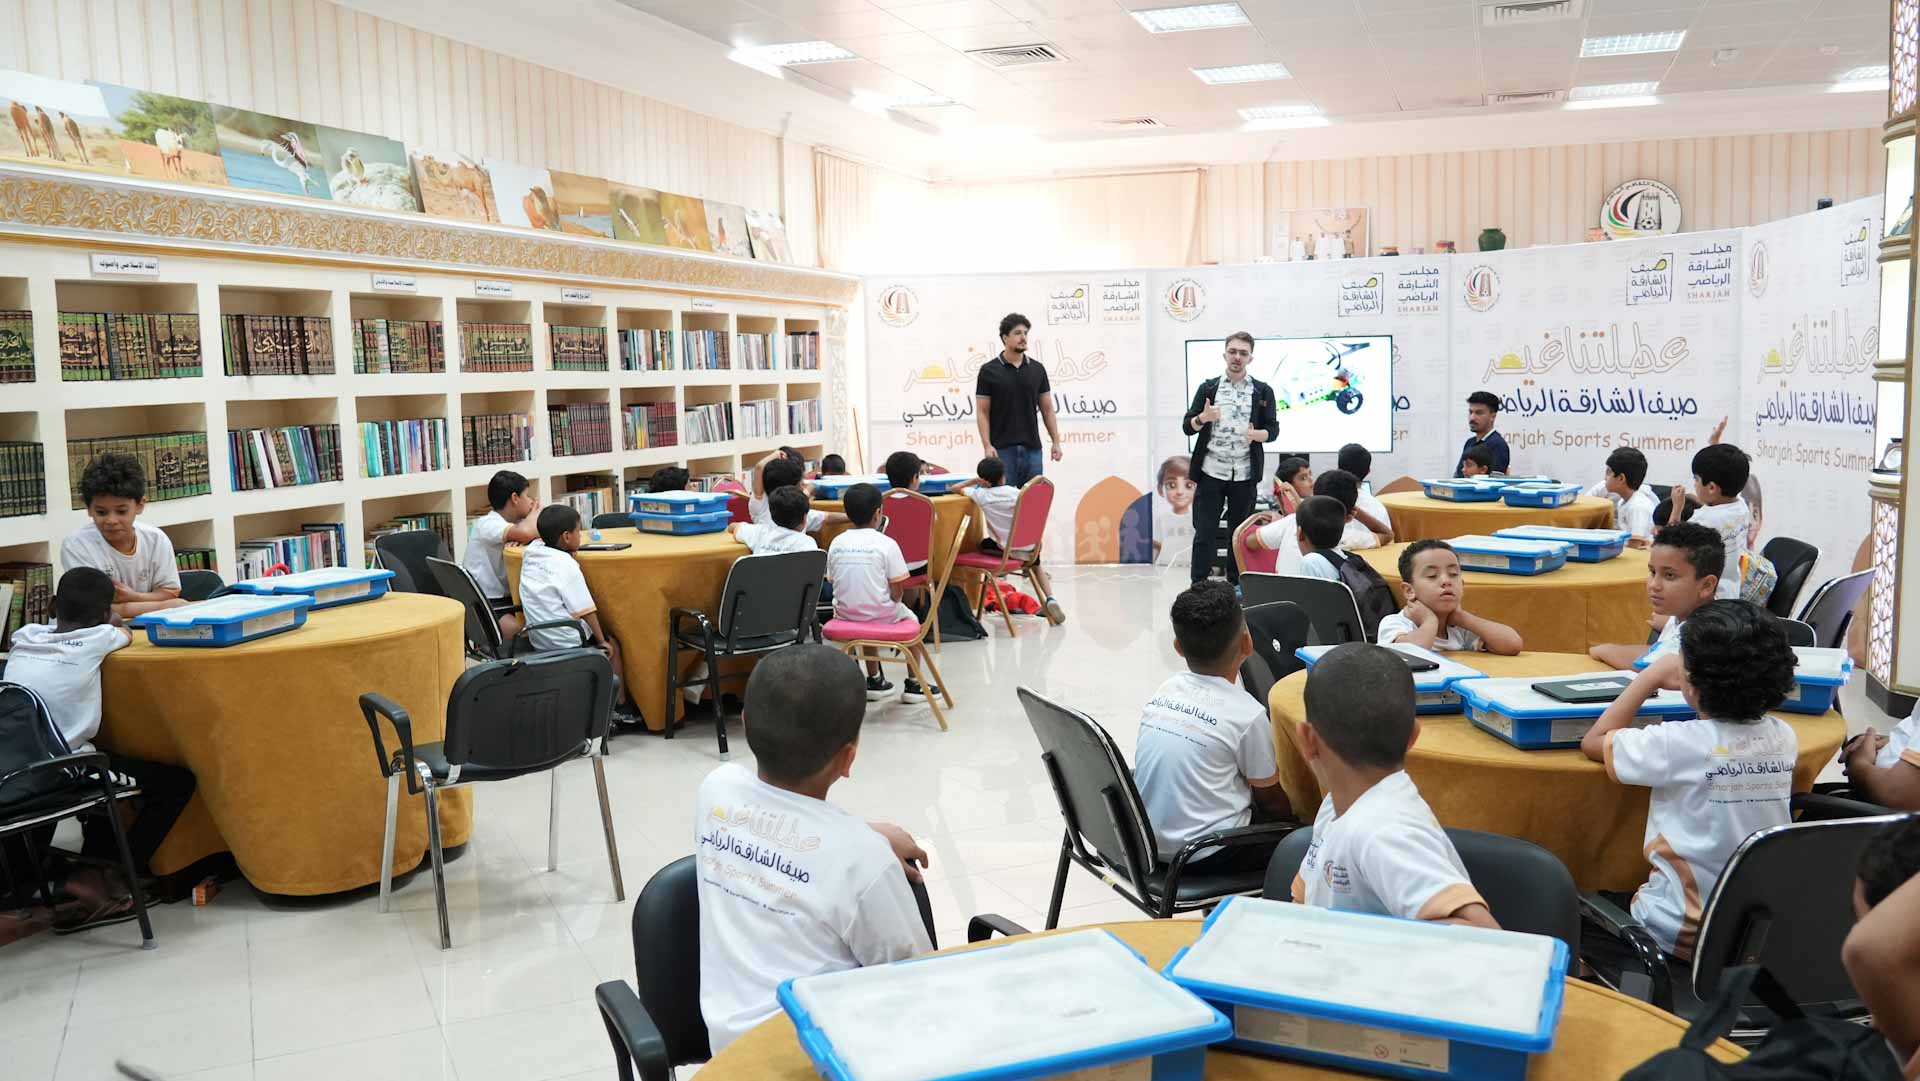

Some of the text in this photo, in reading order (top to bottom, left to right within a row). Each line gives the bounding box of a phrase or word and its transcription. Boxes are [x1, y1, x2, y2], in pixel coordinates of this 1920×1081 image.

[1689, 243, 1732, 255] مجلس
[1399, 266, 1439, 277] مجلس
[1631, 259, 1667, 273] صيف
[1688, 258, 1731, 272] الشارقة
[1103, 278, 1140, 288] مجلس
[1398, 279, 1439, 290] الشارقة
[1632, 274, 1667, 286] الشارقة
[1688, 273, 1730, 288] الرياضي
[1103, 291, 1140, 301] الشارقة
[1343, 290, 1378, 301] الشارقة
[1398, 291, 1438, 303] الرياضي
[1633, 286, 1668, 303] الرياضي
[1688, 290, 1730, 299] SHARJAH
[1103, 303, 1140, 313] الرياضي
[1344, 301, 1379, 313] الرياضي
[1482, 321, 1690, 386] عطلتنا غير
[1072, 395, 1117, 419] صيف
[1559, 387, 1646, 416] الشارقة
[1648, 391, 1697, 420] صيف
[903, 395, 974, 427] لرياضي
[1756, 388, 1876, 434] يف الشارقة الرياضي
[906, 430, 1115, 449] Sharjah ummer
[1504, 428, 1695, 452] arjah Sports Summer
[1757, 439, 1874, 473] Sharjah Sports Summe
[1705, 762, 1747, 780] الرياضي
[1747, 760, 1784, 774] الشارقة
[701, 829, 735, 852] الرياضي
[735, 838, 781, 871] الشارقة
[780, 860, 810, 883] صيف
